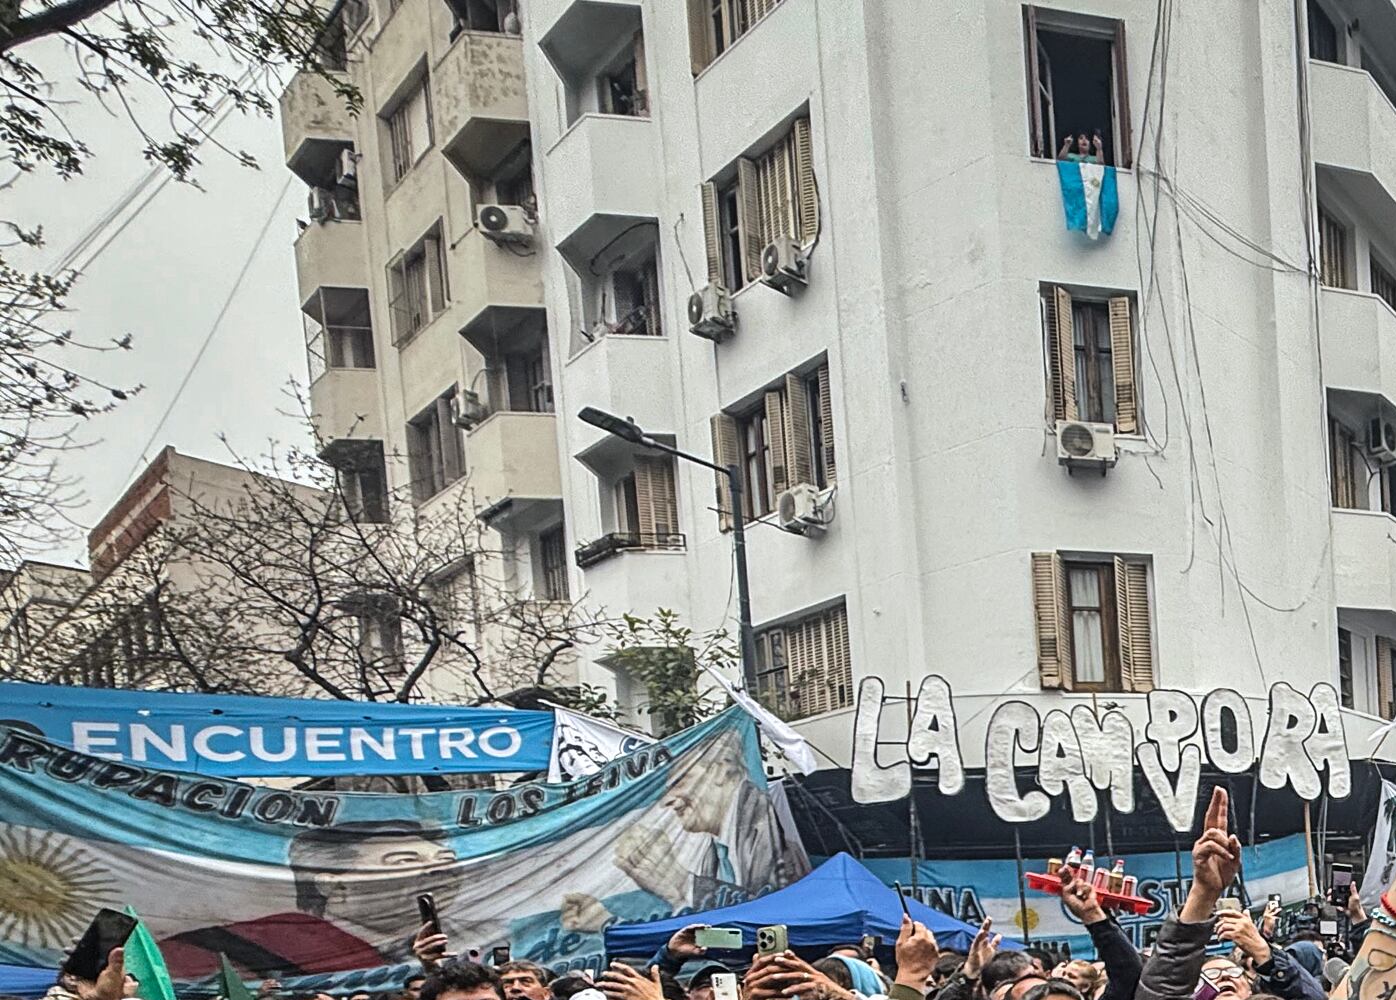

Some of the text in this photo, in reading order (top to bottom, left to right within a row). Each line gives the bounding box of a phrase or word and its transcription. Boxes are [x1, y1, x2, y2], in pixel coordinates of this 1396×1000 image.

[72, 721, 522, 762] ENCUENTRO
[851, 674, 963, 804] LA
[456, 786, 547, 830] LOS
